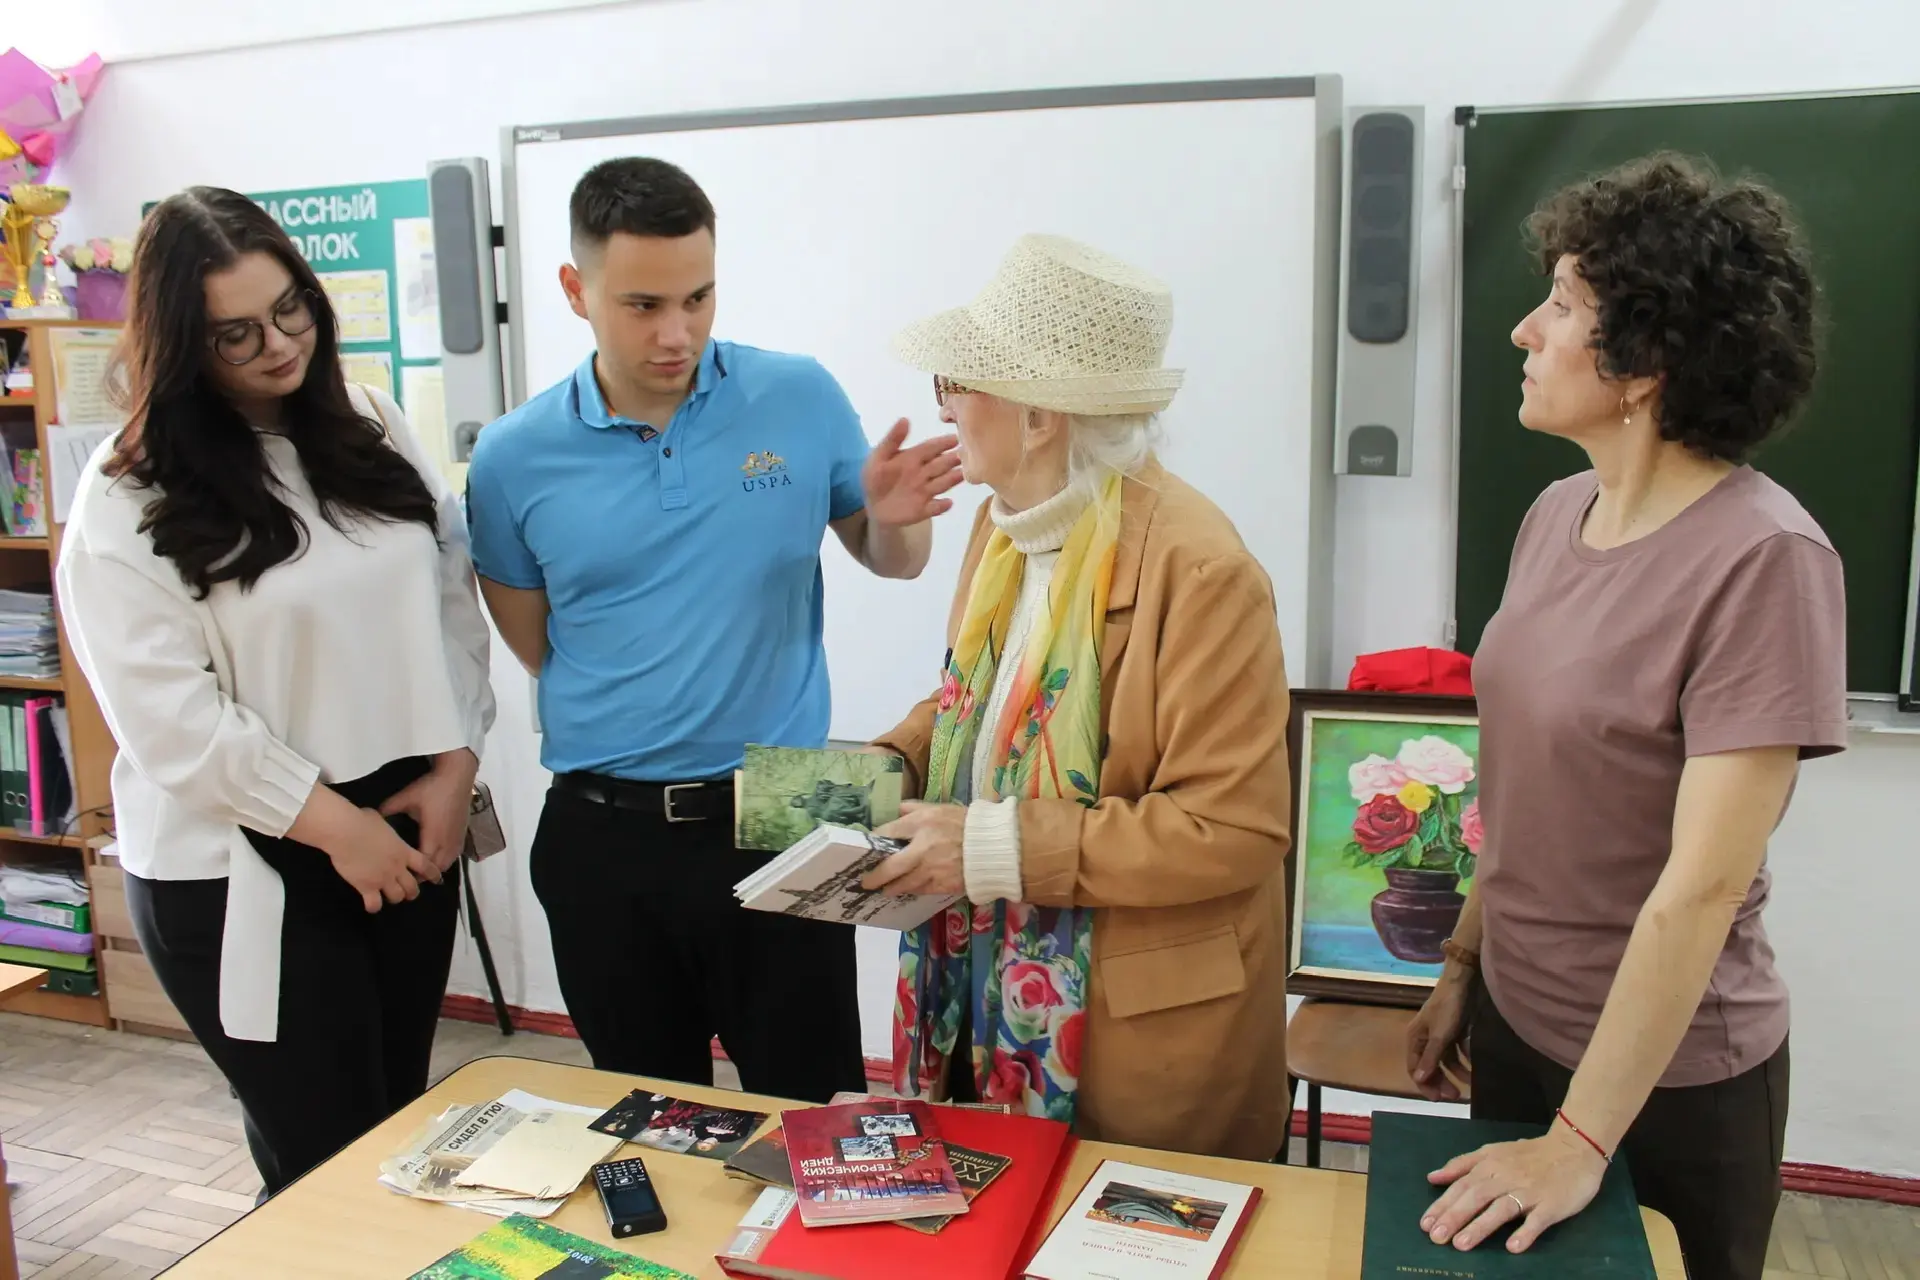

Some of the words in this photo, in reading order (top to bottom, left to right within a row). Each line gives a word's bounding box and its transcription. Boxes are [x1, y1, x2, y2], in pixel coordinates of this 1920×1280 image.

[742, 474, 792, 493] USPA
[448, 1123, 482, 1150] СИДЕЛ
[477, 1116, 489, 1125] В
[800, 1156, 834, 1169] ДНЕЙ
[803, 1163, 893, 1177] ГЕРОИЧЕСКИХ
